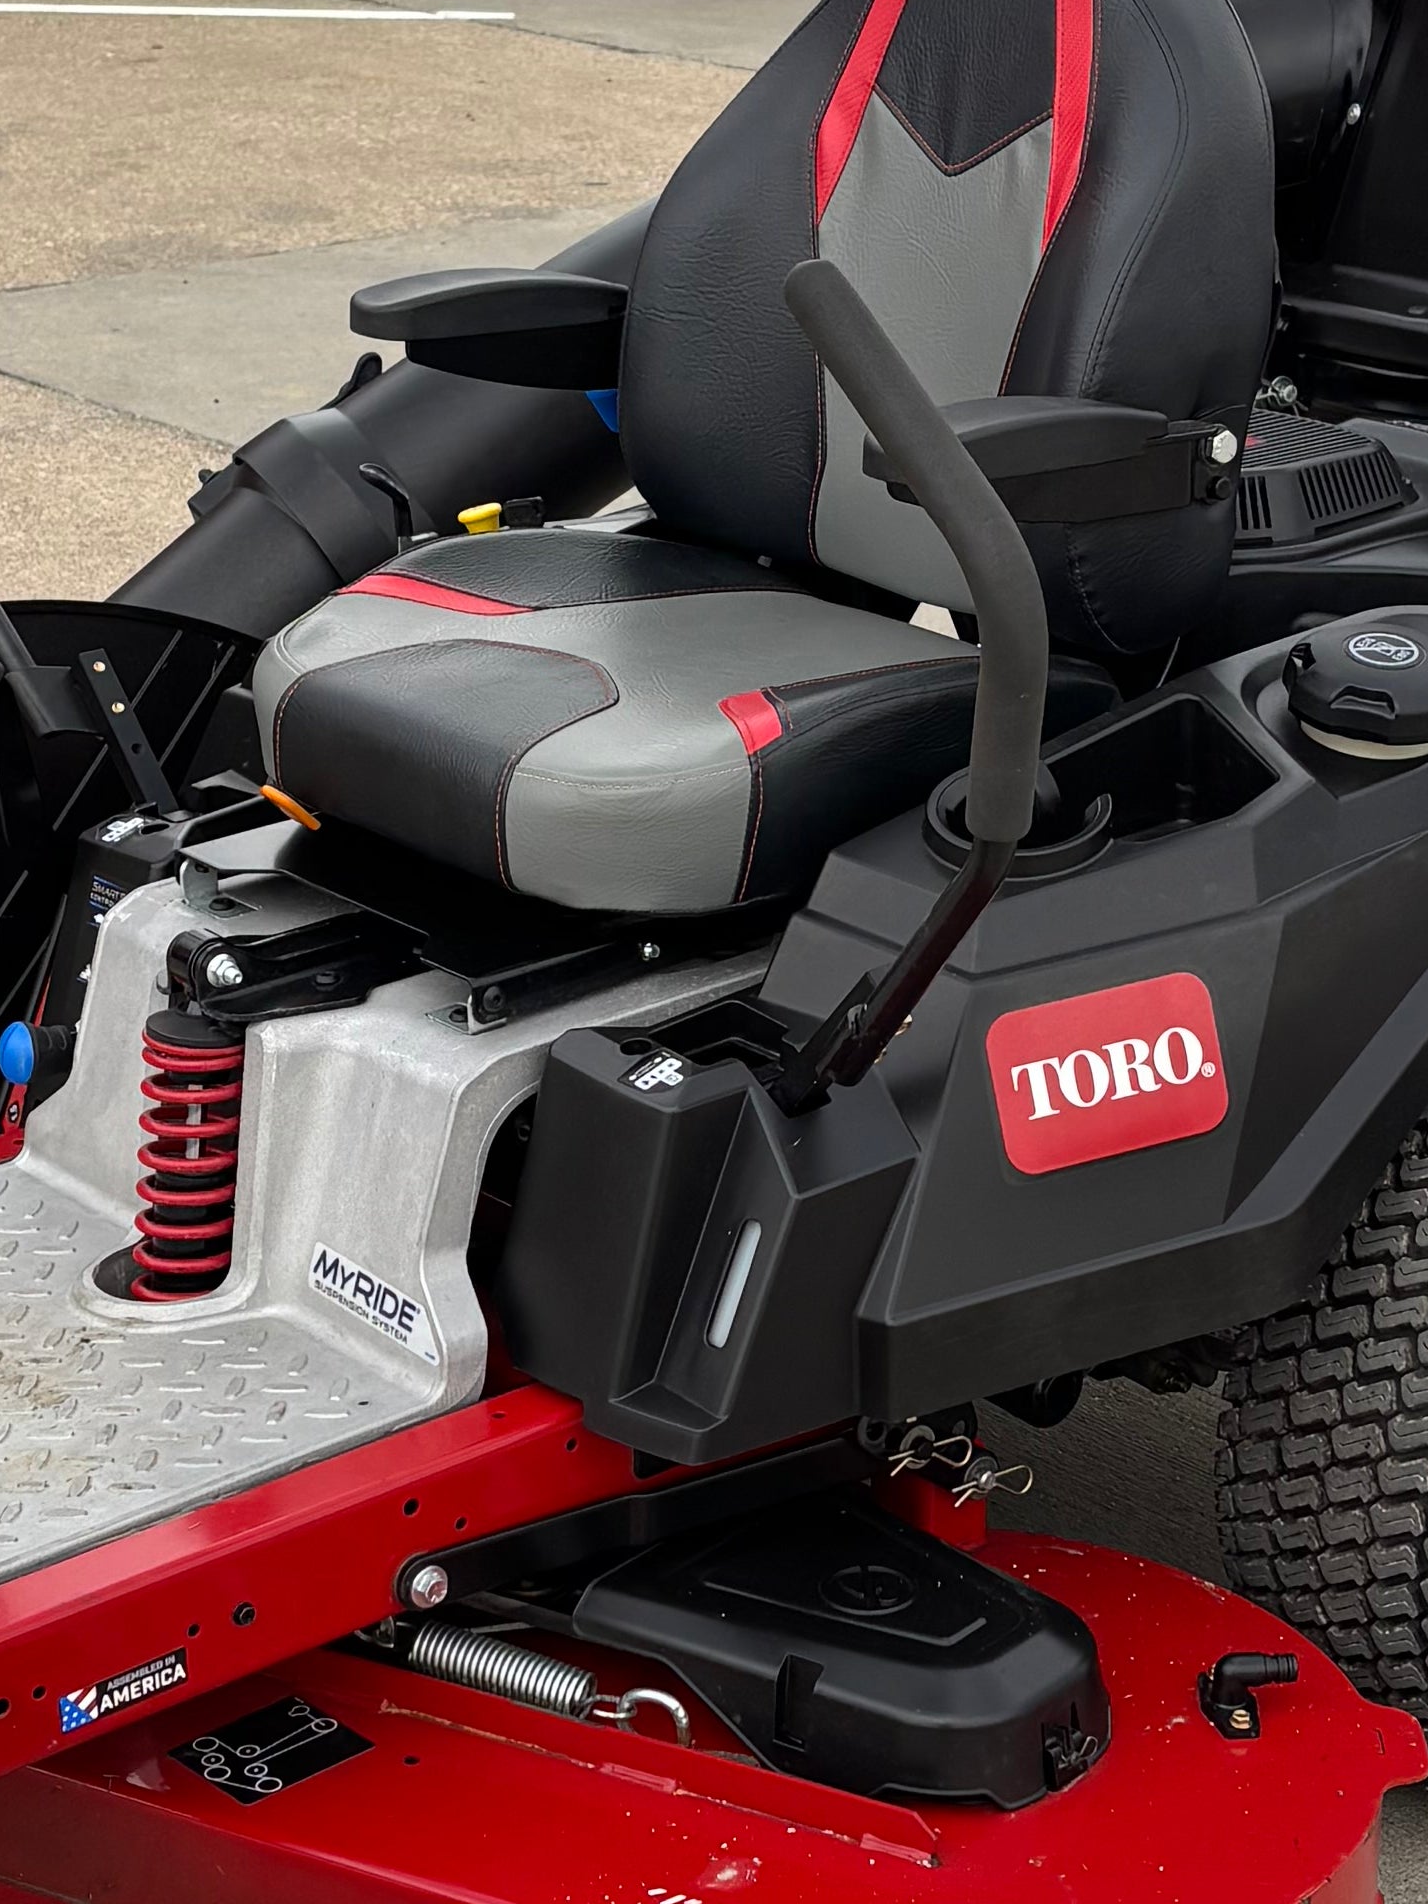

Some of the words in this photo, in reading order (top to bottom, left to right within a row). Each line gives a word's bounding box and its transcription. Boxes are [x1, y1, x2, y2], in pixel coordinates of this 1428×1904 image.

[1010, 1027, 1205, 1121] TORO
[314, 1279, 369, 1319] SUSPENSION
[371, 1315, 408, 1345] SYSTEM
[99, 1663, 187, 1713] AMERICA
[106, 1660, 163, 1691] ASSEMBLED
[164, 1654, 176, 1668] IN
